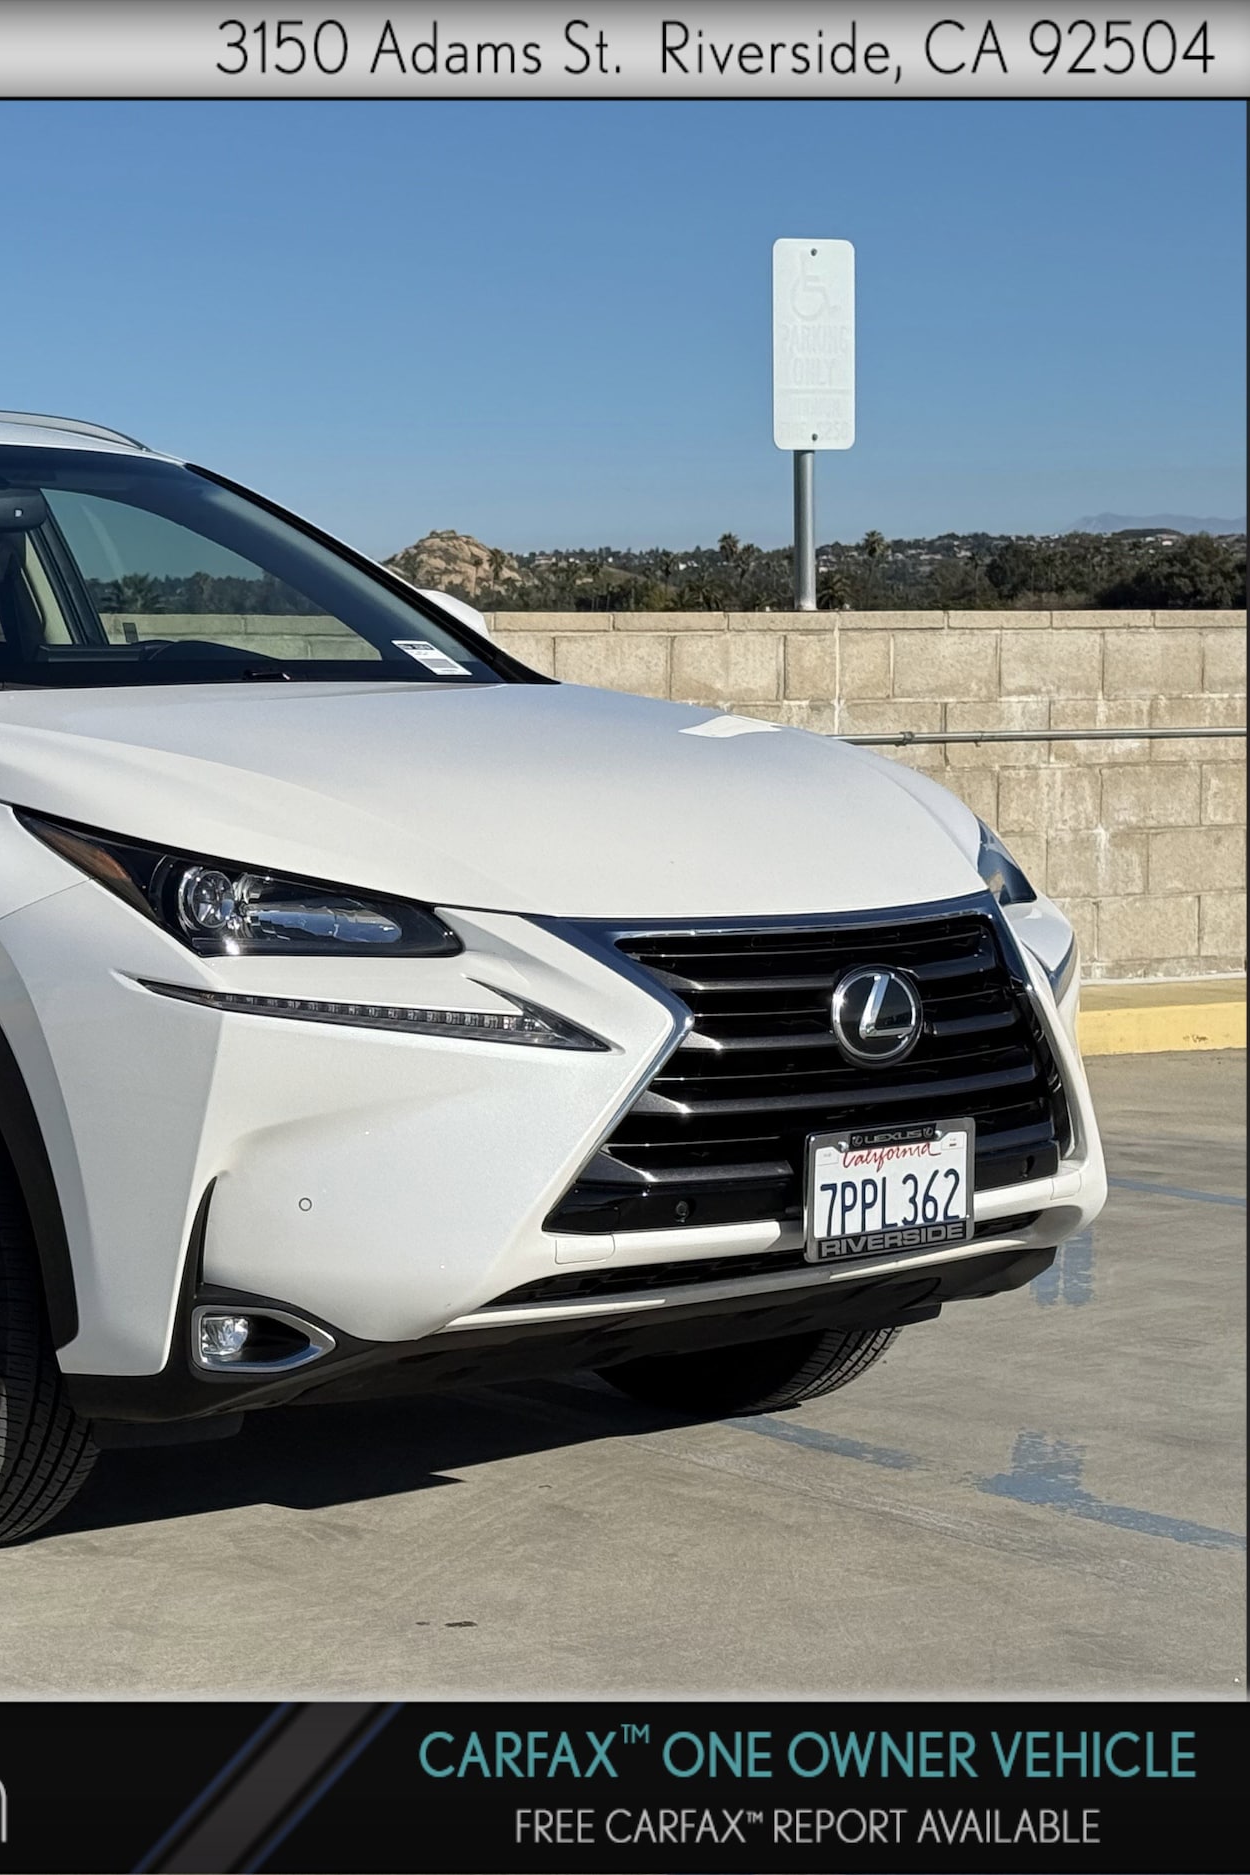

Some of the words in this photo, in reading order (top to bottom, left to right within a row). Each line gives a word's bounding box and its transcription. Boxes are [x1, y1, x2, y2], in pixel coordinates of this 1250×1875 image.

[864, 1128, 922, 1144] LEXUS
[842, 1142, 941, 1173] California
[820, 1168, 960, 1238] 7PPL362
[821, 1222, 964, 1258] RIVERSIDE
